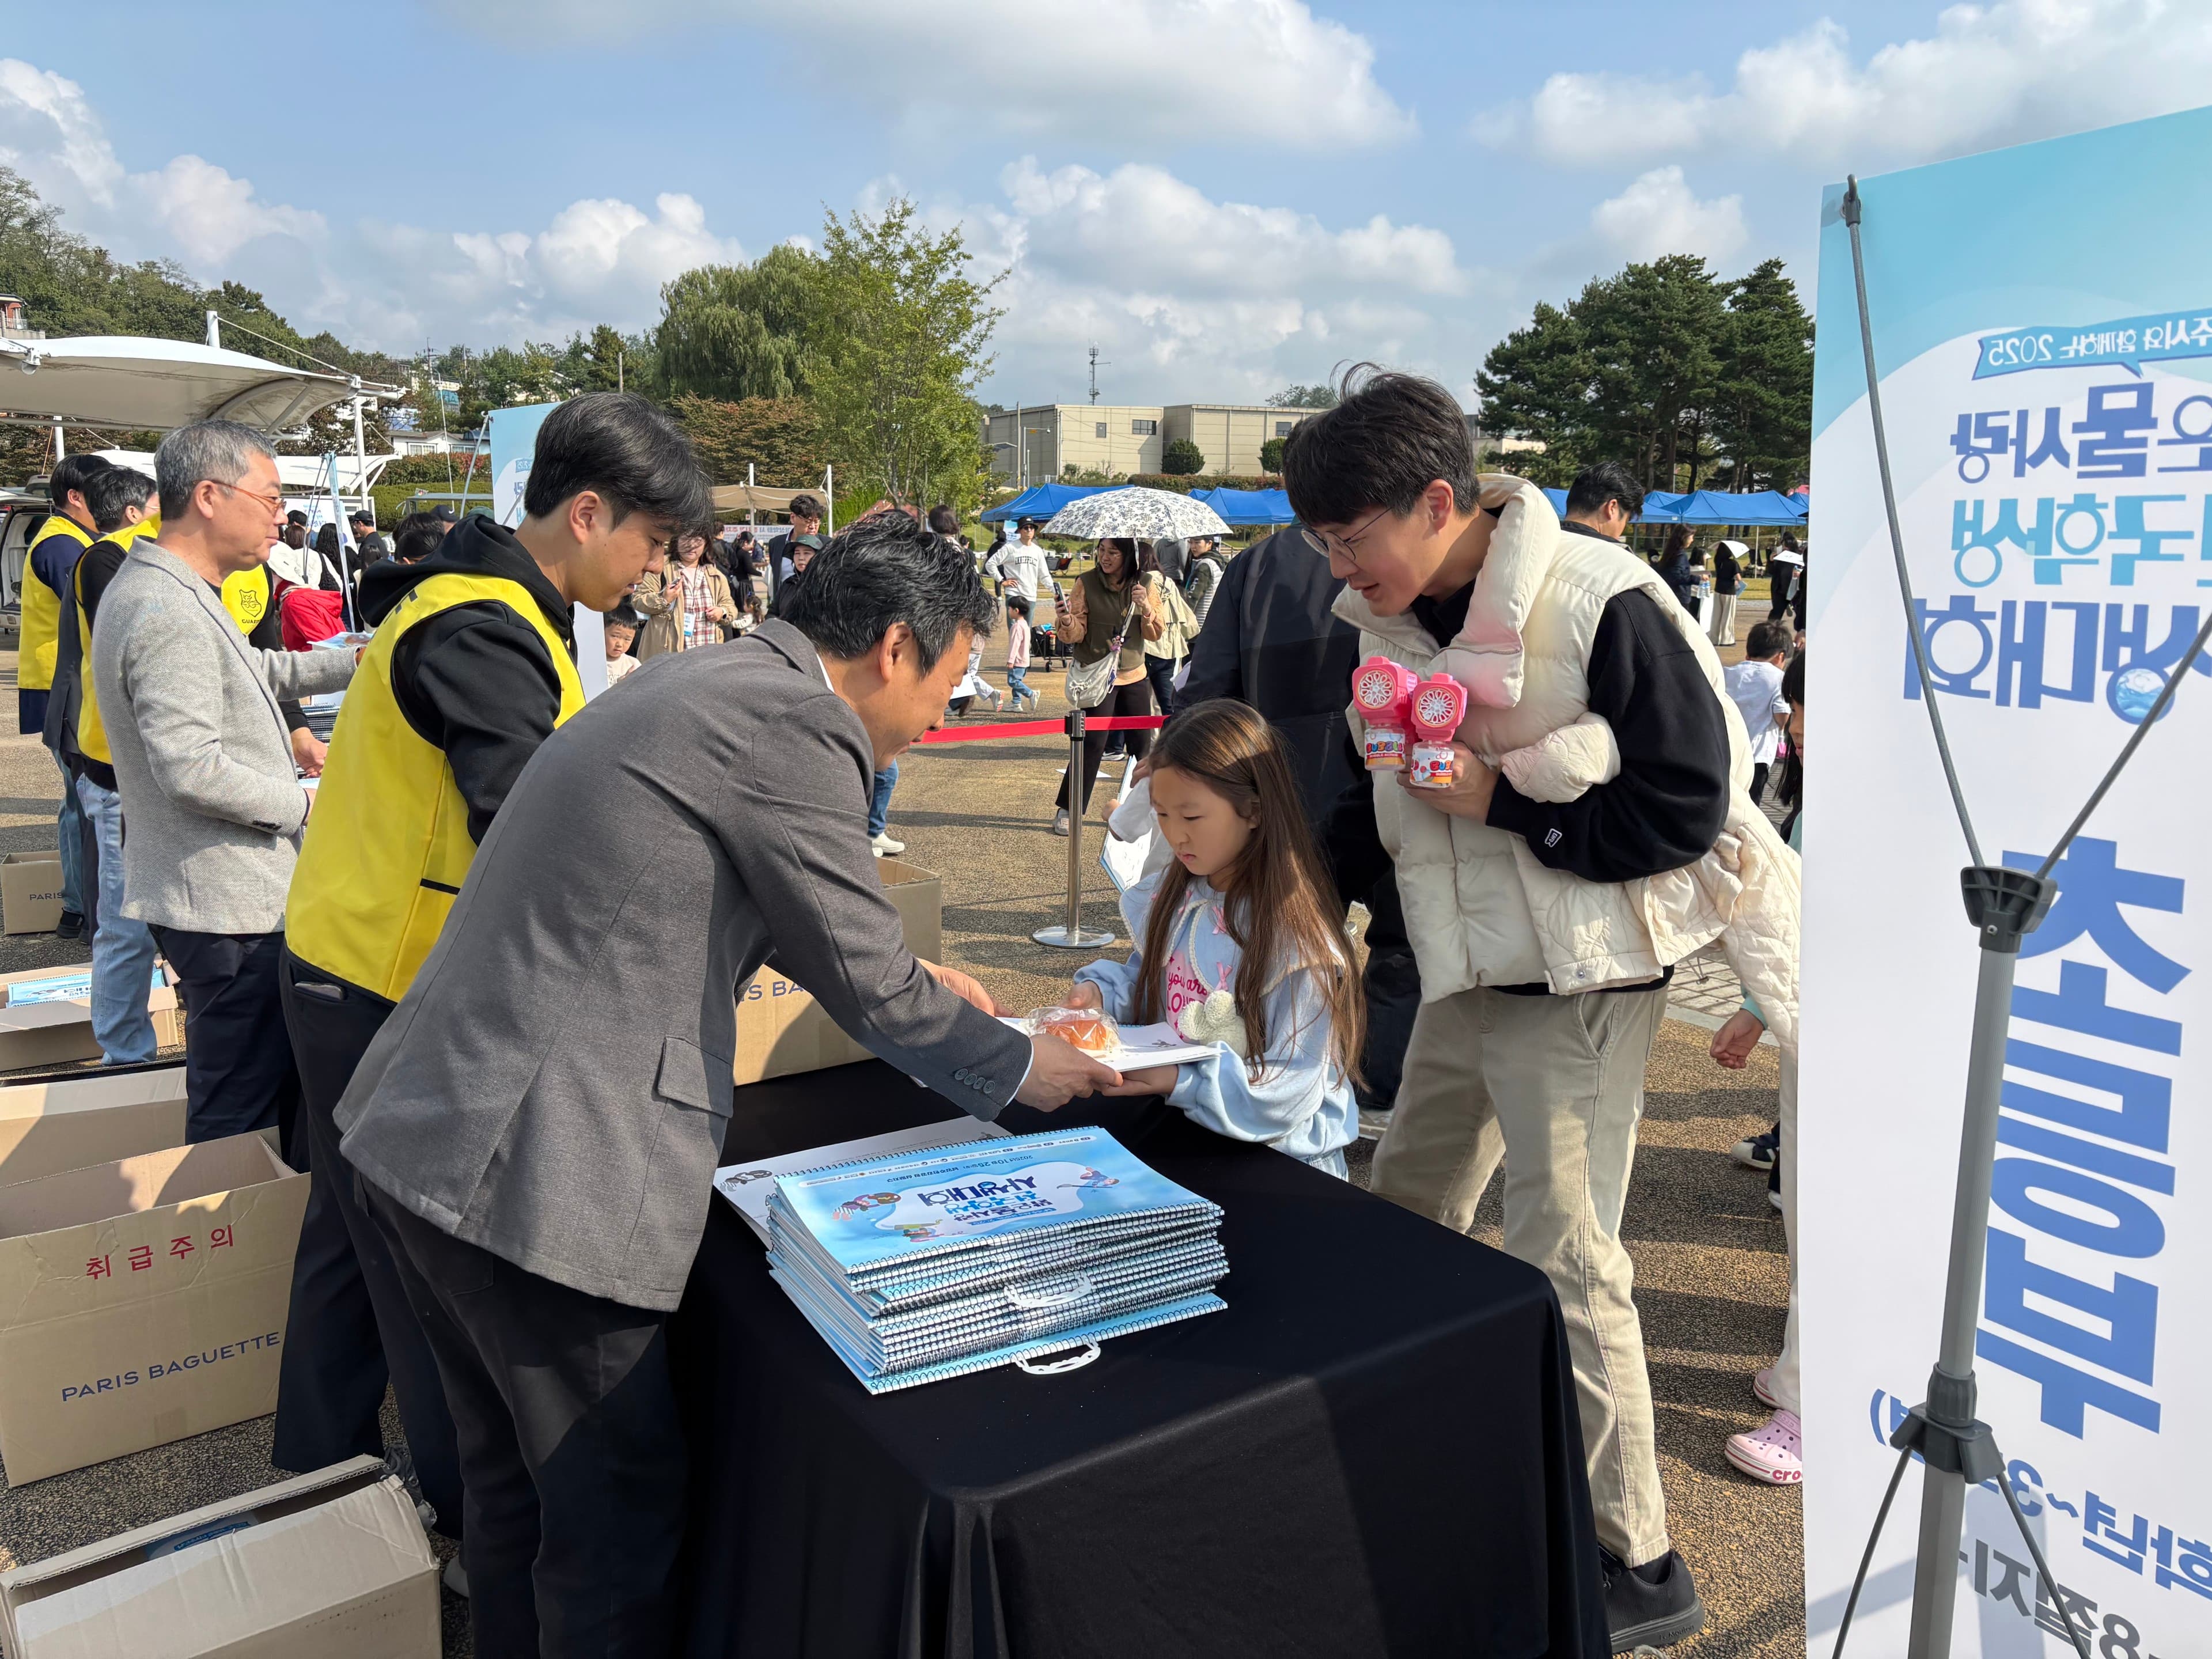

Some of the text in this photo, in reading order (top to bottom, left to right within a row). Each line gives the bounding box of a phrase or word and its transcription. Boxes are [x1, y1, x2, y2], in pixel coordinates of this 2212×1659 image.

[29, 892, 63, 900] PARIS
[1168, 972, 1185, 991] you
[741, 984, 763, 1002] S
[917, 1175, 1038, 1207] 사생대회
[62, 1331, 280, 1402] PARIS BAGUETTE
[1772, 1469, 1802, 1480] cro
